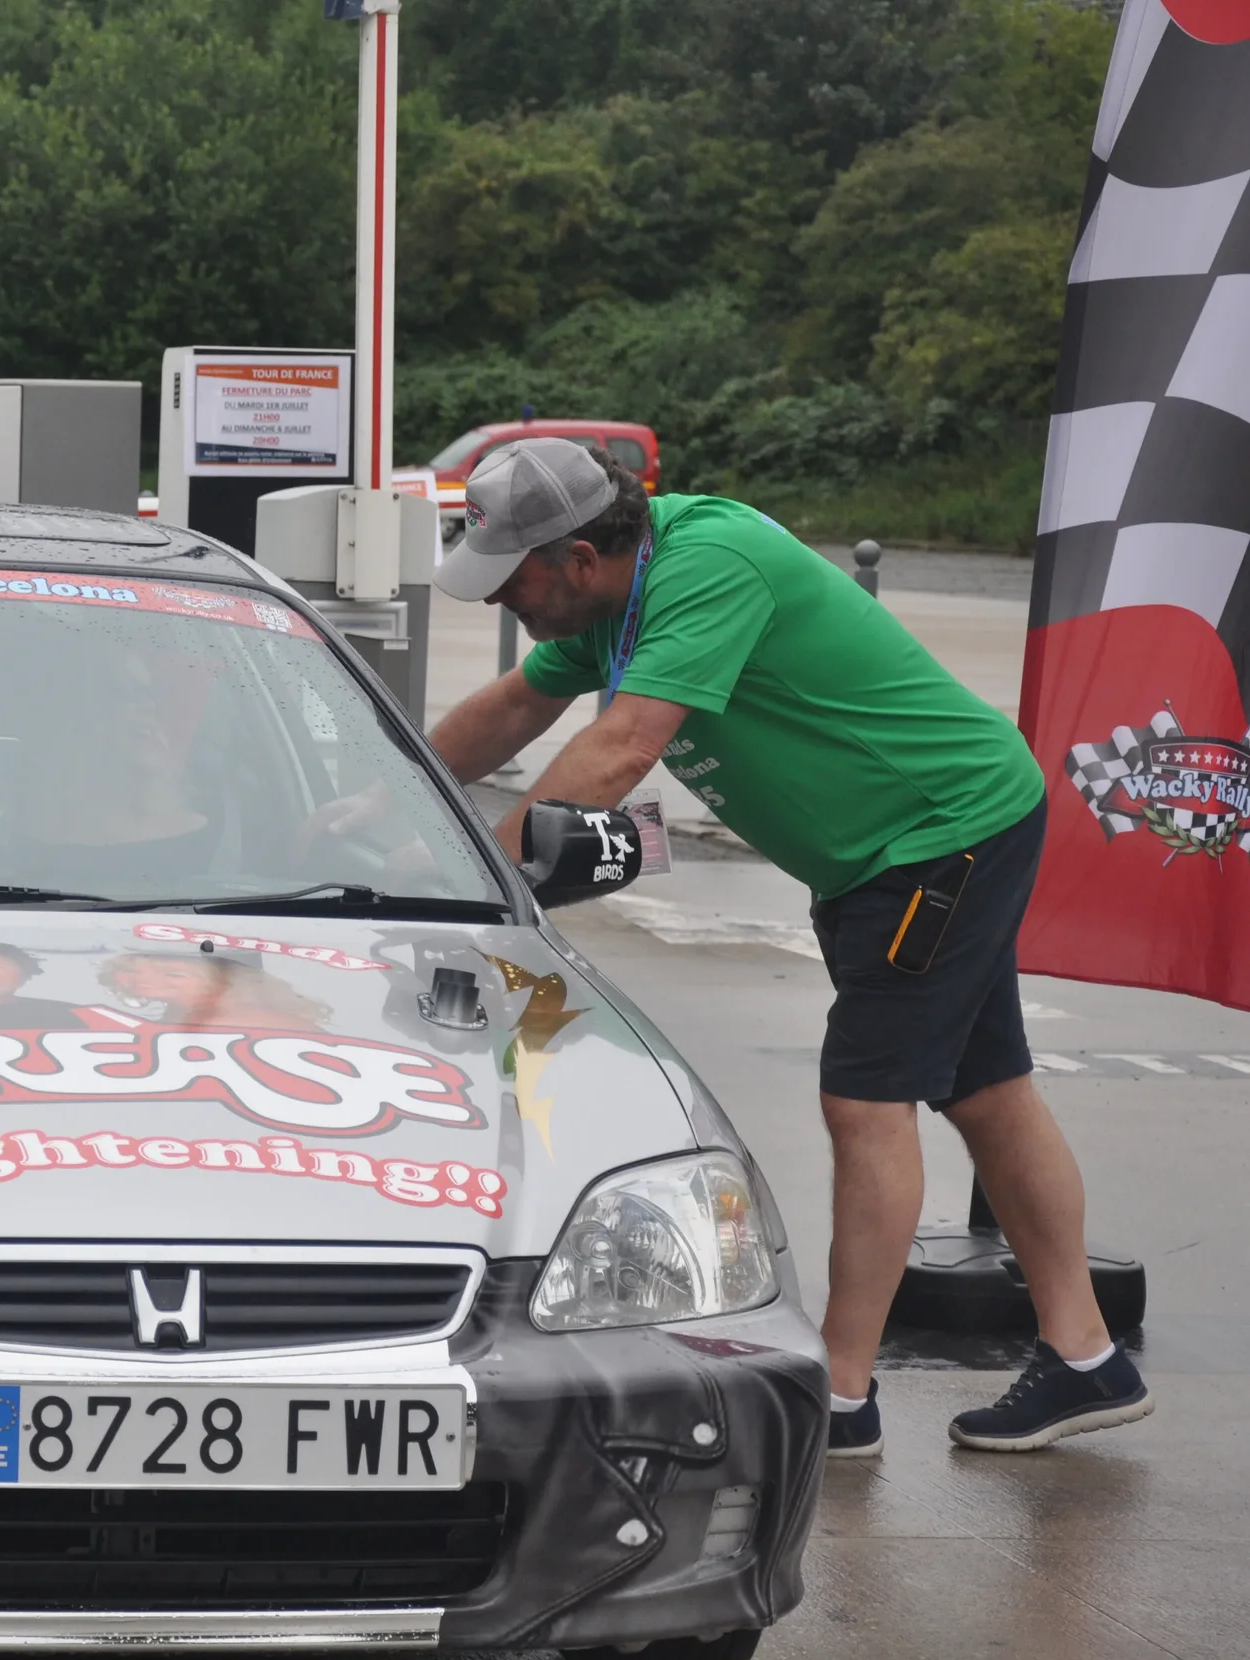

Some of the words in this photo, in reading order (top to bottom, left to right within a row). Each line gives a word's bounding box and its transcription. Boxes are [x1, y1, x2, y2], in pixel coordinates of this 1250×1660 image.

[252, 369, 278, 378] TOUR
[281, 369, 293, 379] DE
[296, 369, 333, 380] FRANCE
[222, 387, 272, 396] FERMETURE
[275, 387, 289, 396] DU
[290, 387, 312, 396] PARC
[224, 401, 236, 410] DU
[238, 401, 264, 410] MARDI
[221, 425, 233, 433] AU
[235, 425, 276, 433] DIMANCHE
[284, 425, 312, 434] JUILLET
[1119, 771, 1218, 805] Wacky
[593, 864, 625, 883] BIRDS
[135, 923, 393, 970] Sandy
[28, 1395, 244, 1474] 8728
[286, 1399, 440, 1475] FWR
